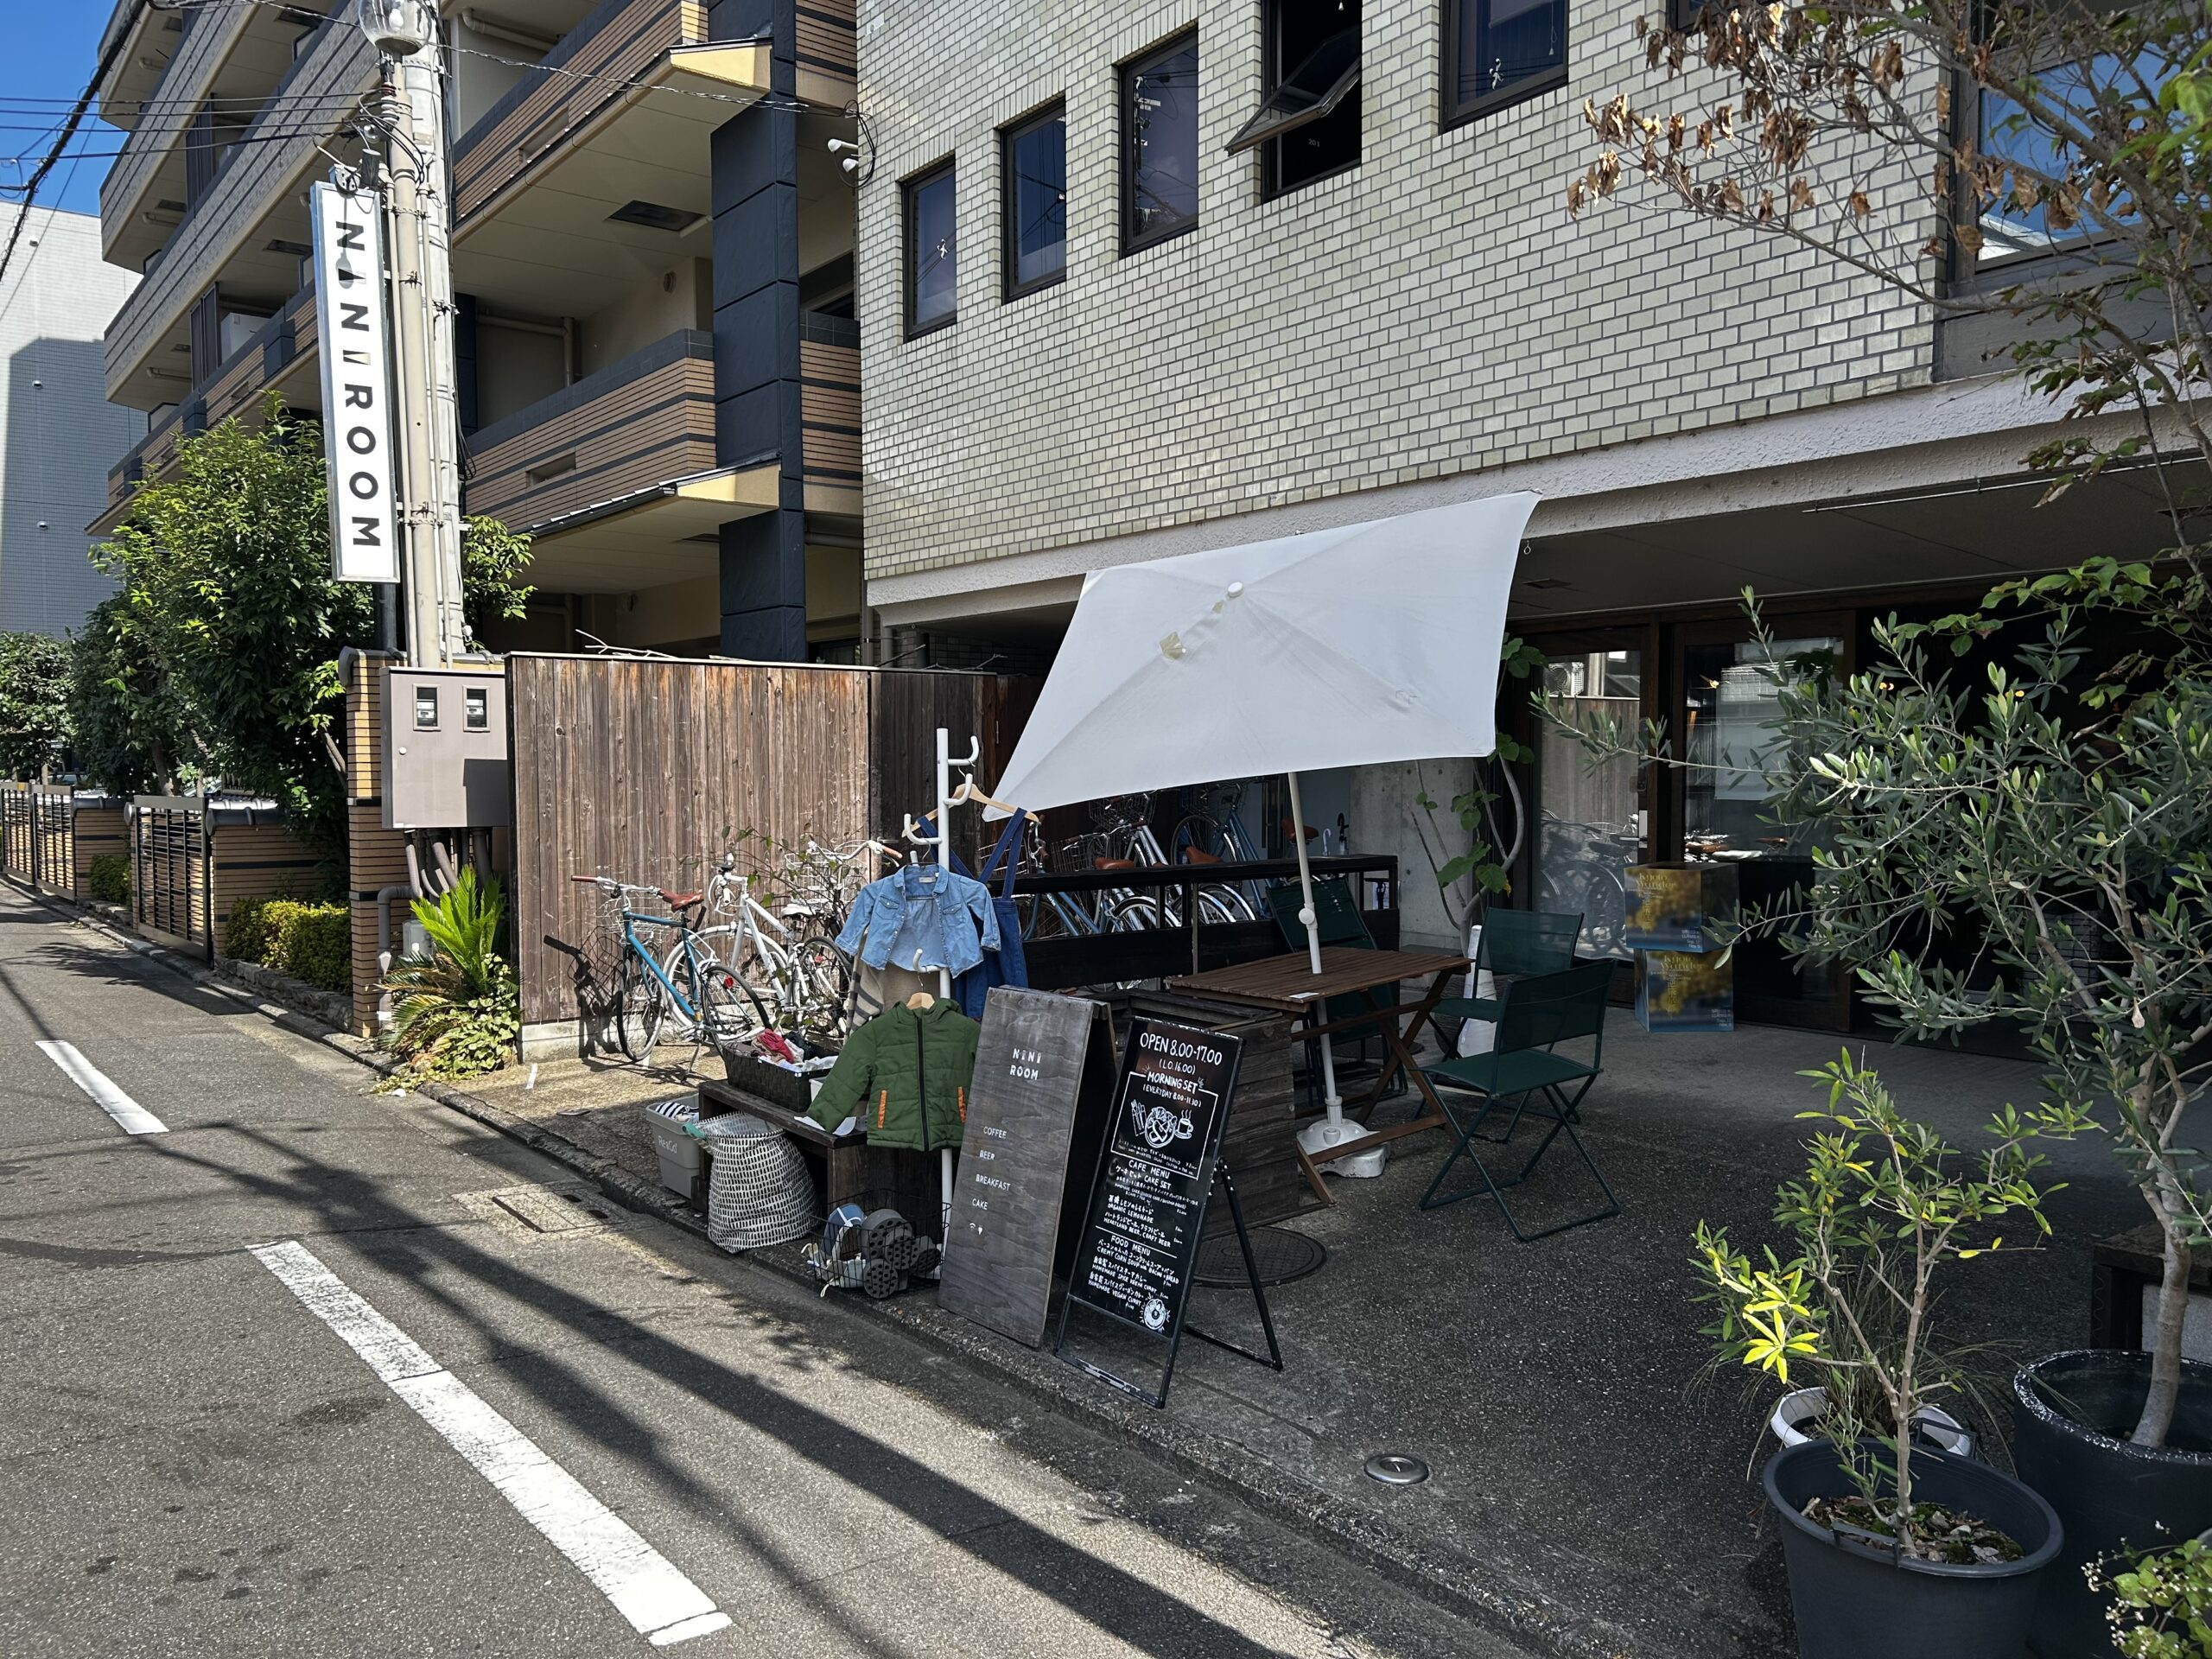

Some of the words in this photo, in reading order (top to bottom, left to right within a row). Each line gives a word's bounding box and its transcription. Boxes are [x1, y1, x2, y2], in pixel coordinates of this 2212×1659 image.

[1141, 1033, 1169, 1052] OPEN
[1009, 1065, 1039, 1080] ROOM
[1147, 1071, 1183, 1089] MORNING
[1183, 1080, 1198, 1094] SET
[983, 1126, 1007, 1140] COFFEE
[979, 1150, 995, 1161] BEER
[1129, 1160, 1147, 1172] CAFE
[1151, 1167, 1170, 1179] MENU
[975, 1173, 1012, 1192] BREAKFAST
[1144, 1175, 1159, 1185] CAKE
[971, 1198, 989, 1211] CAKE
[1108, 1204, 1126, 1213] ORGANIC
[1128, 1210, 1154, 1223] LEMONADE
[1104, 1217, 1128, 1230] HEARTLAND
[1142, 1232, 1157, 1242] CRAFT
[1159, 1238, 1170, 1247] BEER
[1111, 1236, 1128, 1247] FOOD
[1132, 1243, 1150, 1255] MENU
[1115, 1253, 1127, 1262] CORN
[1128, 1259, 1140, 1268] SOUP
